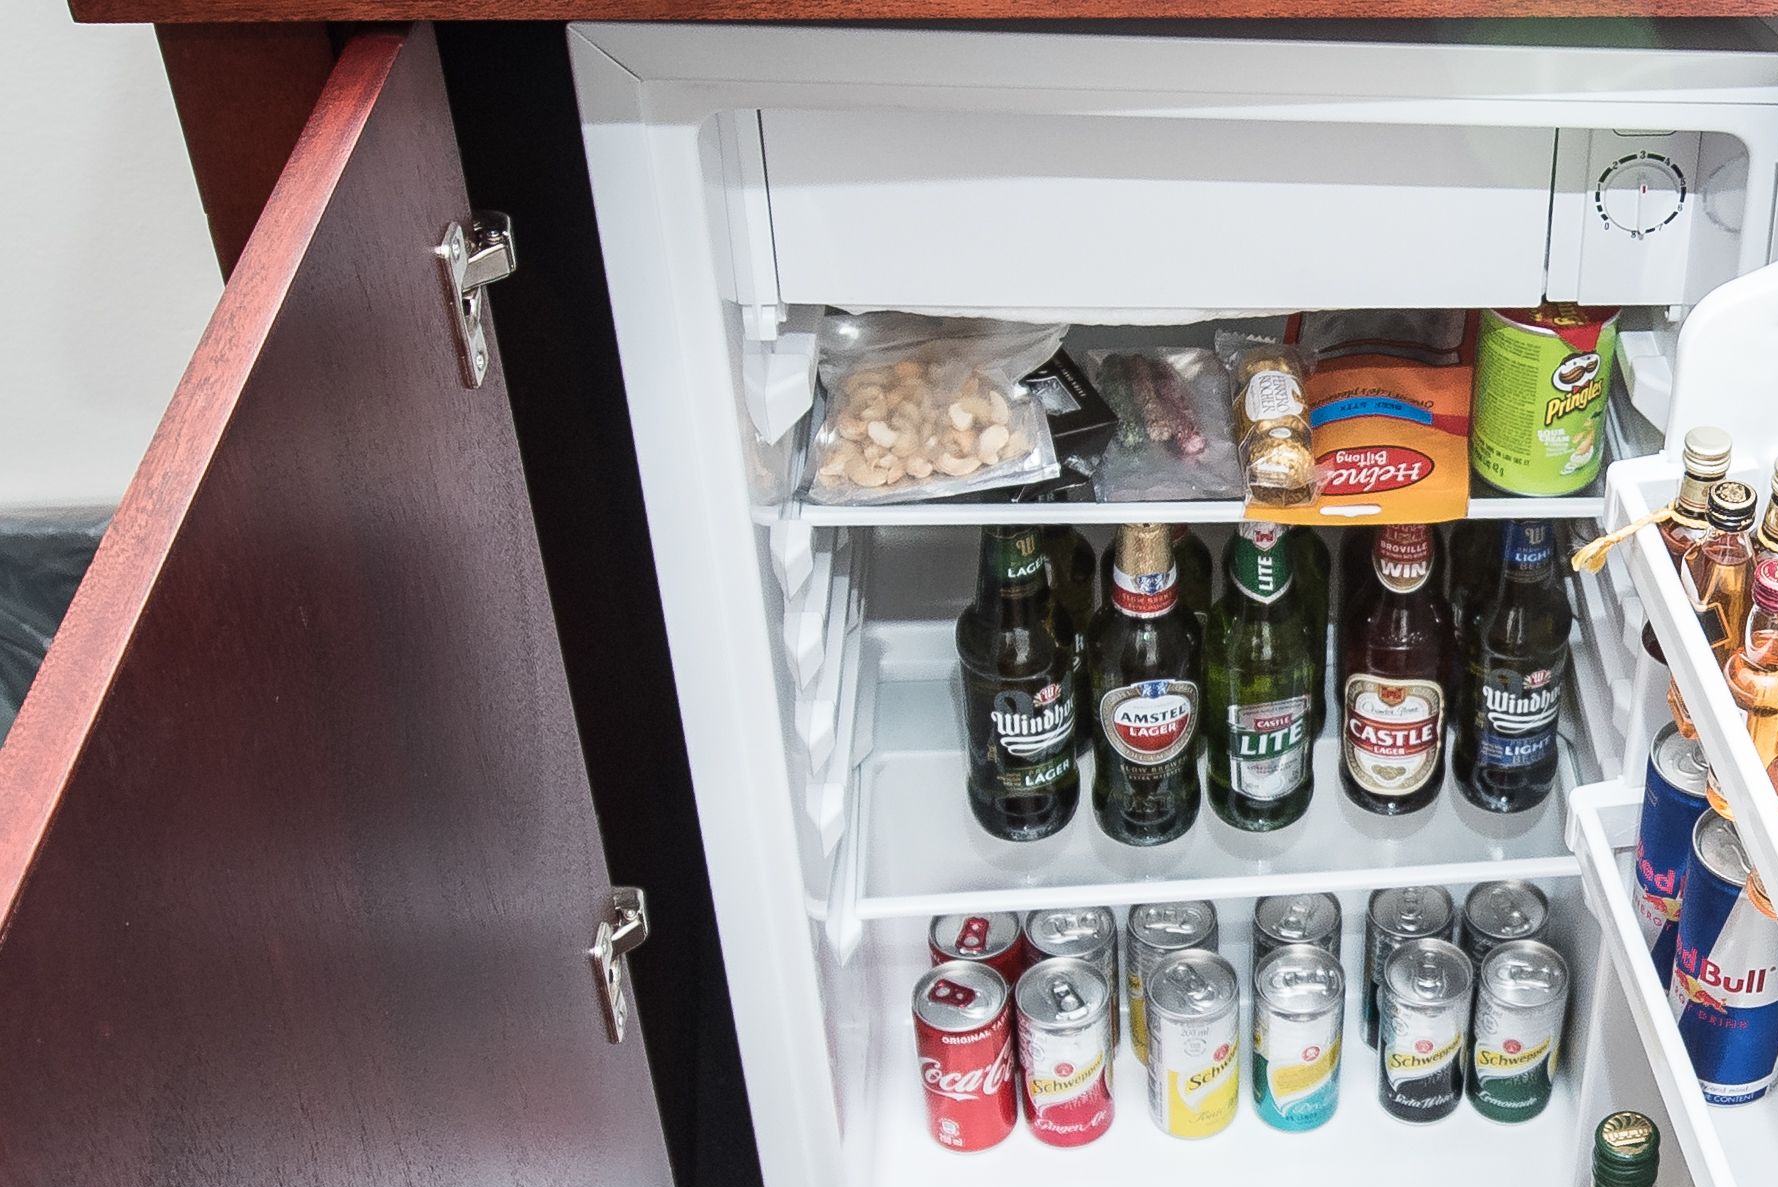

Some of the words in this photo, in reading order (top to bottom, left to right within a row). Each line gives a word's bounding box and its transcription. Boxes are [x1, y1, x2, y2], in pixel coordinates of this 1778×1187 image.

[1544, 378, 1604, 427] Pringles
[1336, 451, 1388, 466] Biltong
[1326, 462, 1423, 491] Heine
[1257, 555, 1274, 591] LITE
[1380, 559, 1427, 578] WIN
[1482, 686, 1560, 714] Windho
[990, 697, 1074, 736] Windho
[1121, 705, 1186, 724] AMSTEL
[1257, 716, 1290, 728] CASTLE
[1129, 723, 1176, 737] LAGER
[1240, 718, 1303, 755] LITE
[1349, 718, 1433, 746] CASTLE
[1373, 746, 1405, 755] LAGER
[1505, 735, 1551, 756] LIGHT
[1025, 759, 1070, 786] LAGER
[1700, 958, 1767, 994] Bull
[941, 1030, 992, 1045] ORIGINAL
[1713, 1092, 1756, 1103] CONTENT
